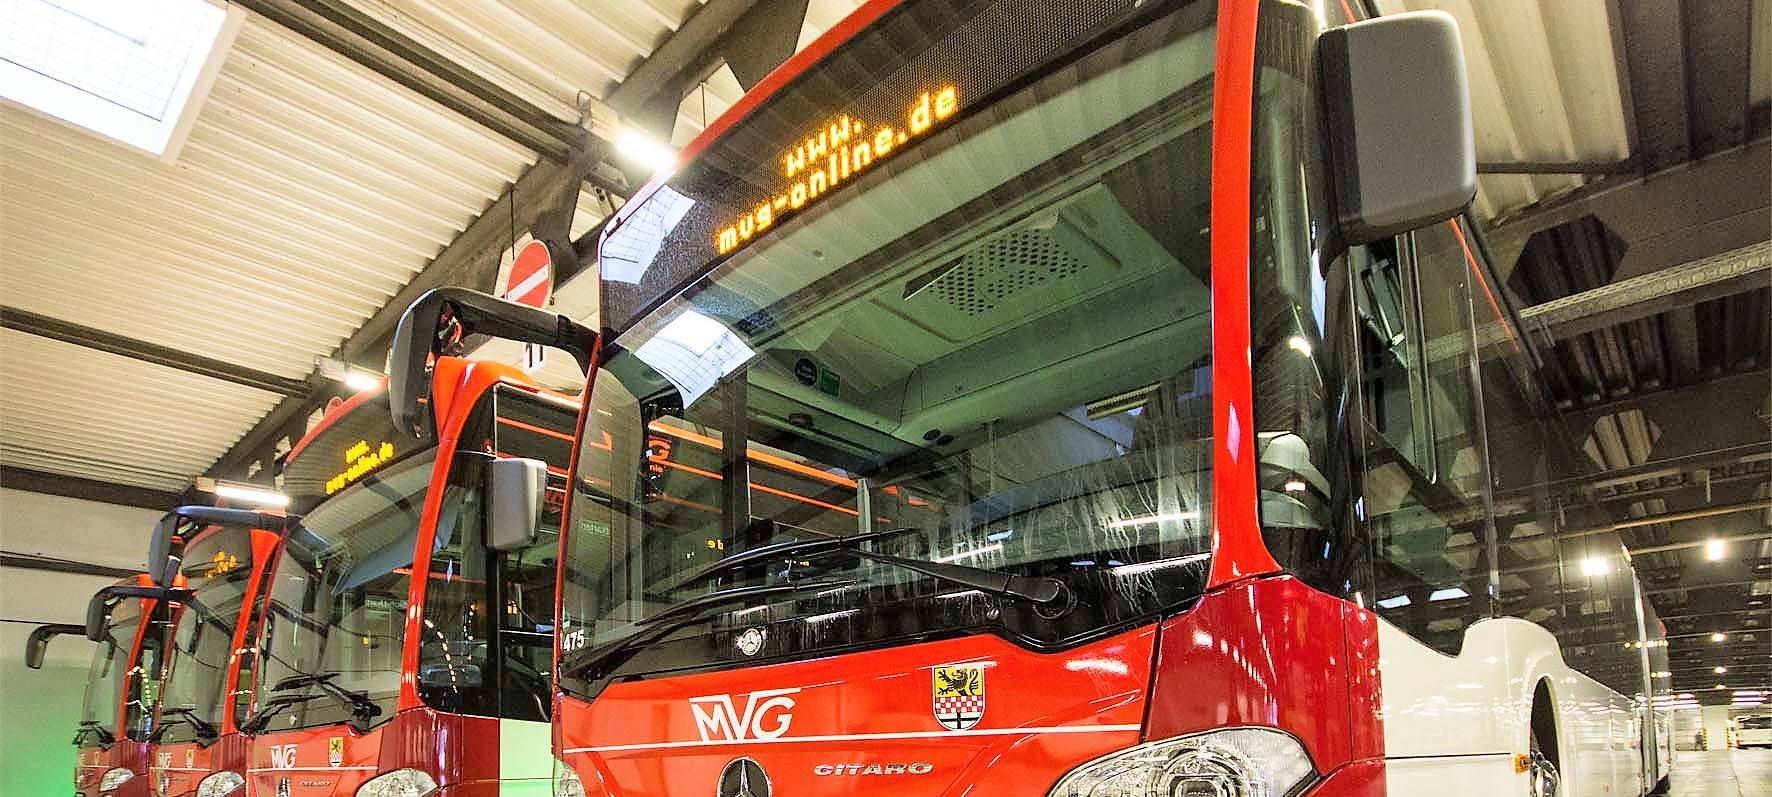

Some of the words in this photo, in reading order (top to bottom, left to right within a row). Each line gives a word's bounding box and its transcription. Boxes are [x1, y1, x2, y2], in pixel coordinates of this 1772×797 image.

[718, 84, 959, 254] mvg-online.de
[785, 113, 863, 179] www.
[688, 687, 801, 742] MVG
[270, 743, 298, 768] MVG
[814, 761, 934, 776] CITARO
